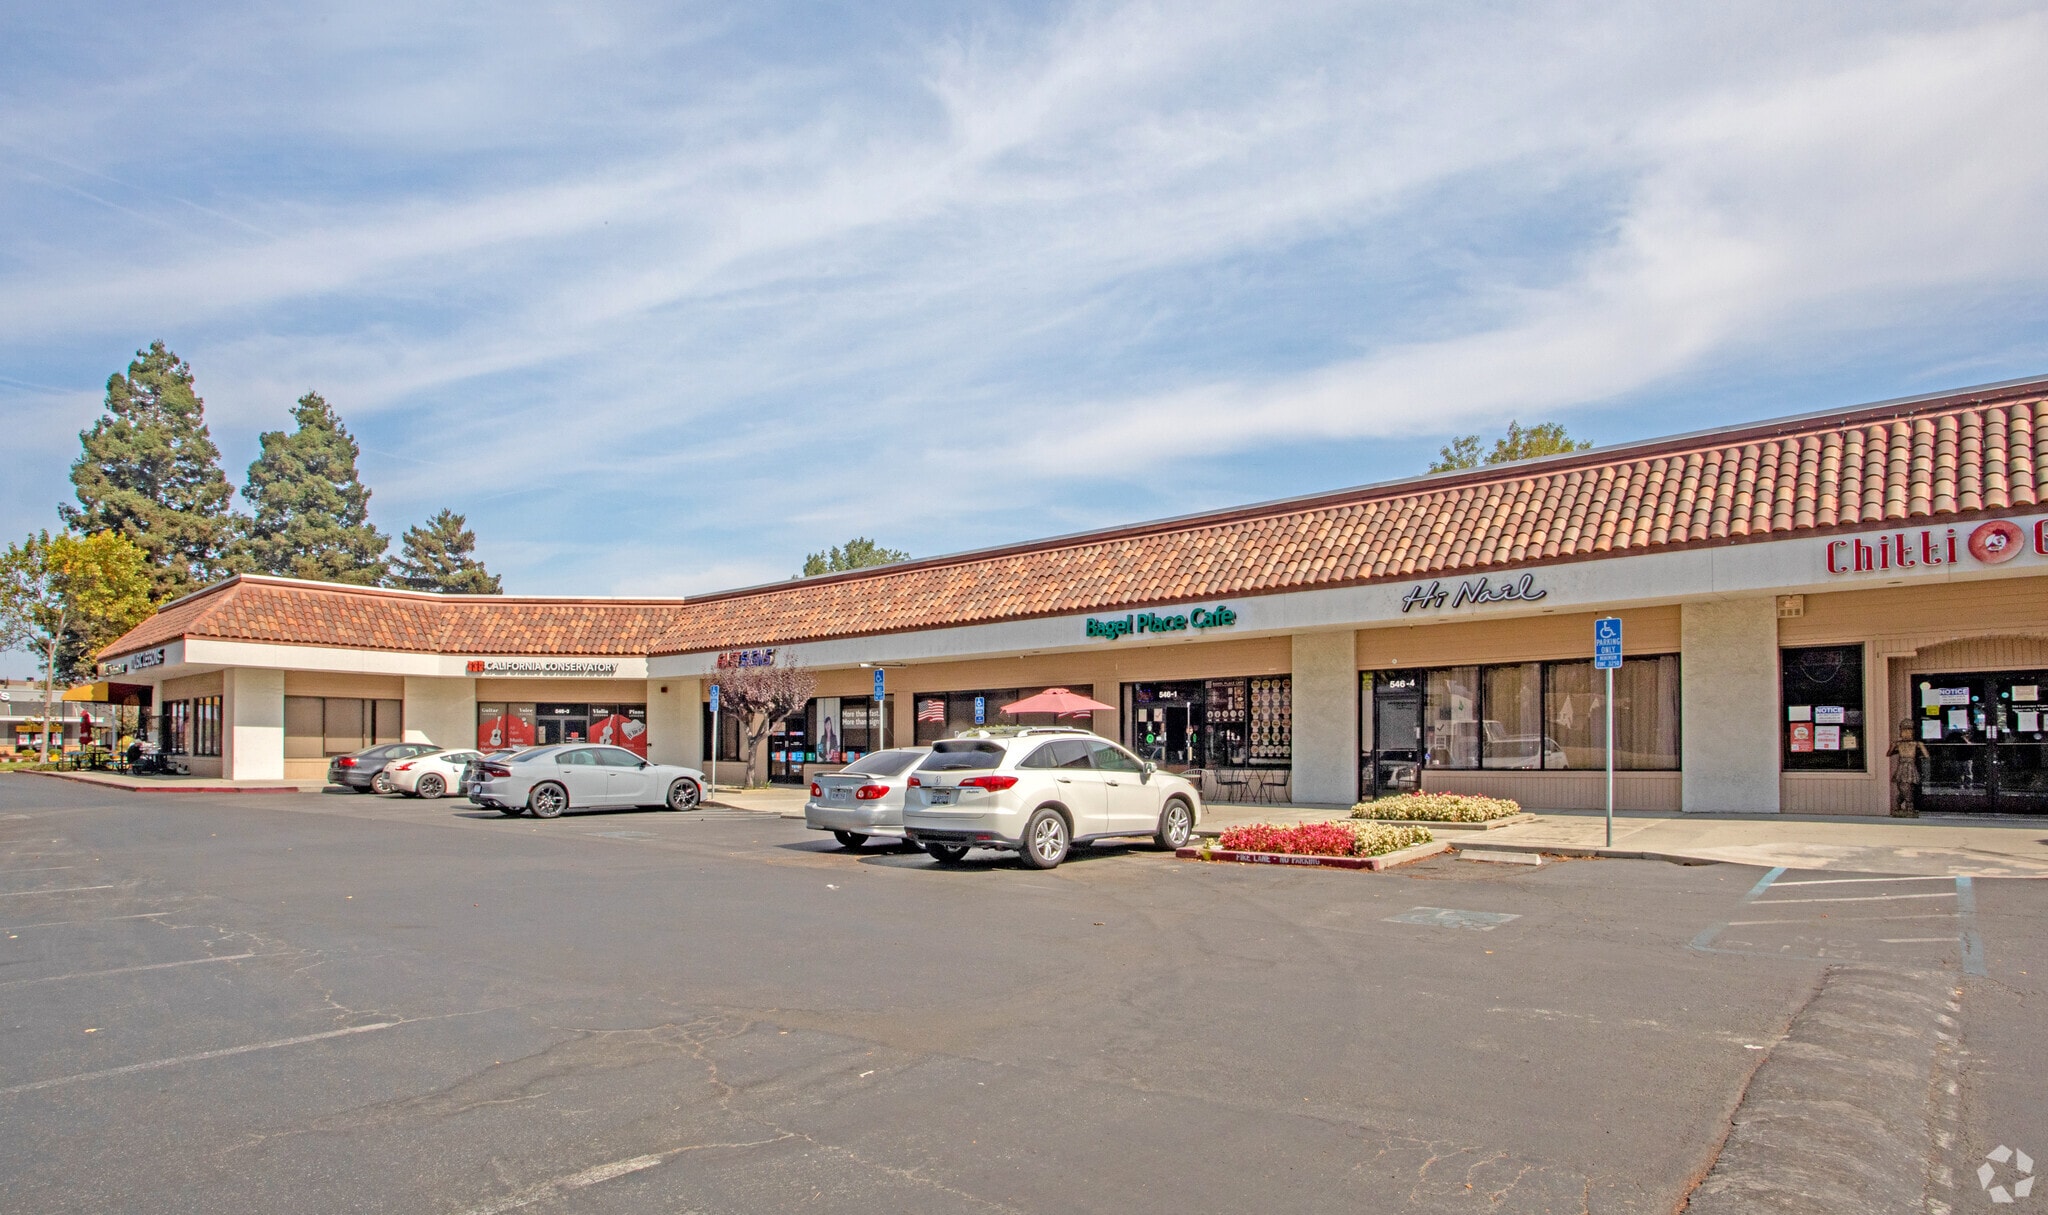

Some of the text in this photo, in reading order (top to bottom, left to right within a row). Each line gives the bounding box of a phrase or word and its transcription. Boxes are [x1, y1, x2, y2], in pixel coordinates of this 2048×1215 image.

[1825, 528, 1958, 575] Chitti
[1402, 573, 1547, 612] Hi Nail
[1086, 605, 1236, 640] Bagel Place Cafe
[1596, 638, 1621, 646] PARKING
[1601, 646, 1616, 654] ONLY
[485, 661, 619, 672] CALIFORNIA CONSERVATORY
[1389, 679, 1415, 688] 546-4
